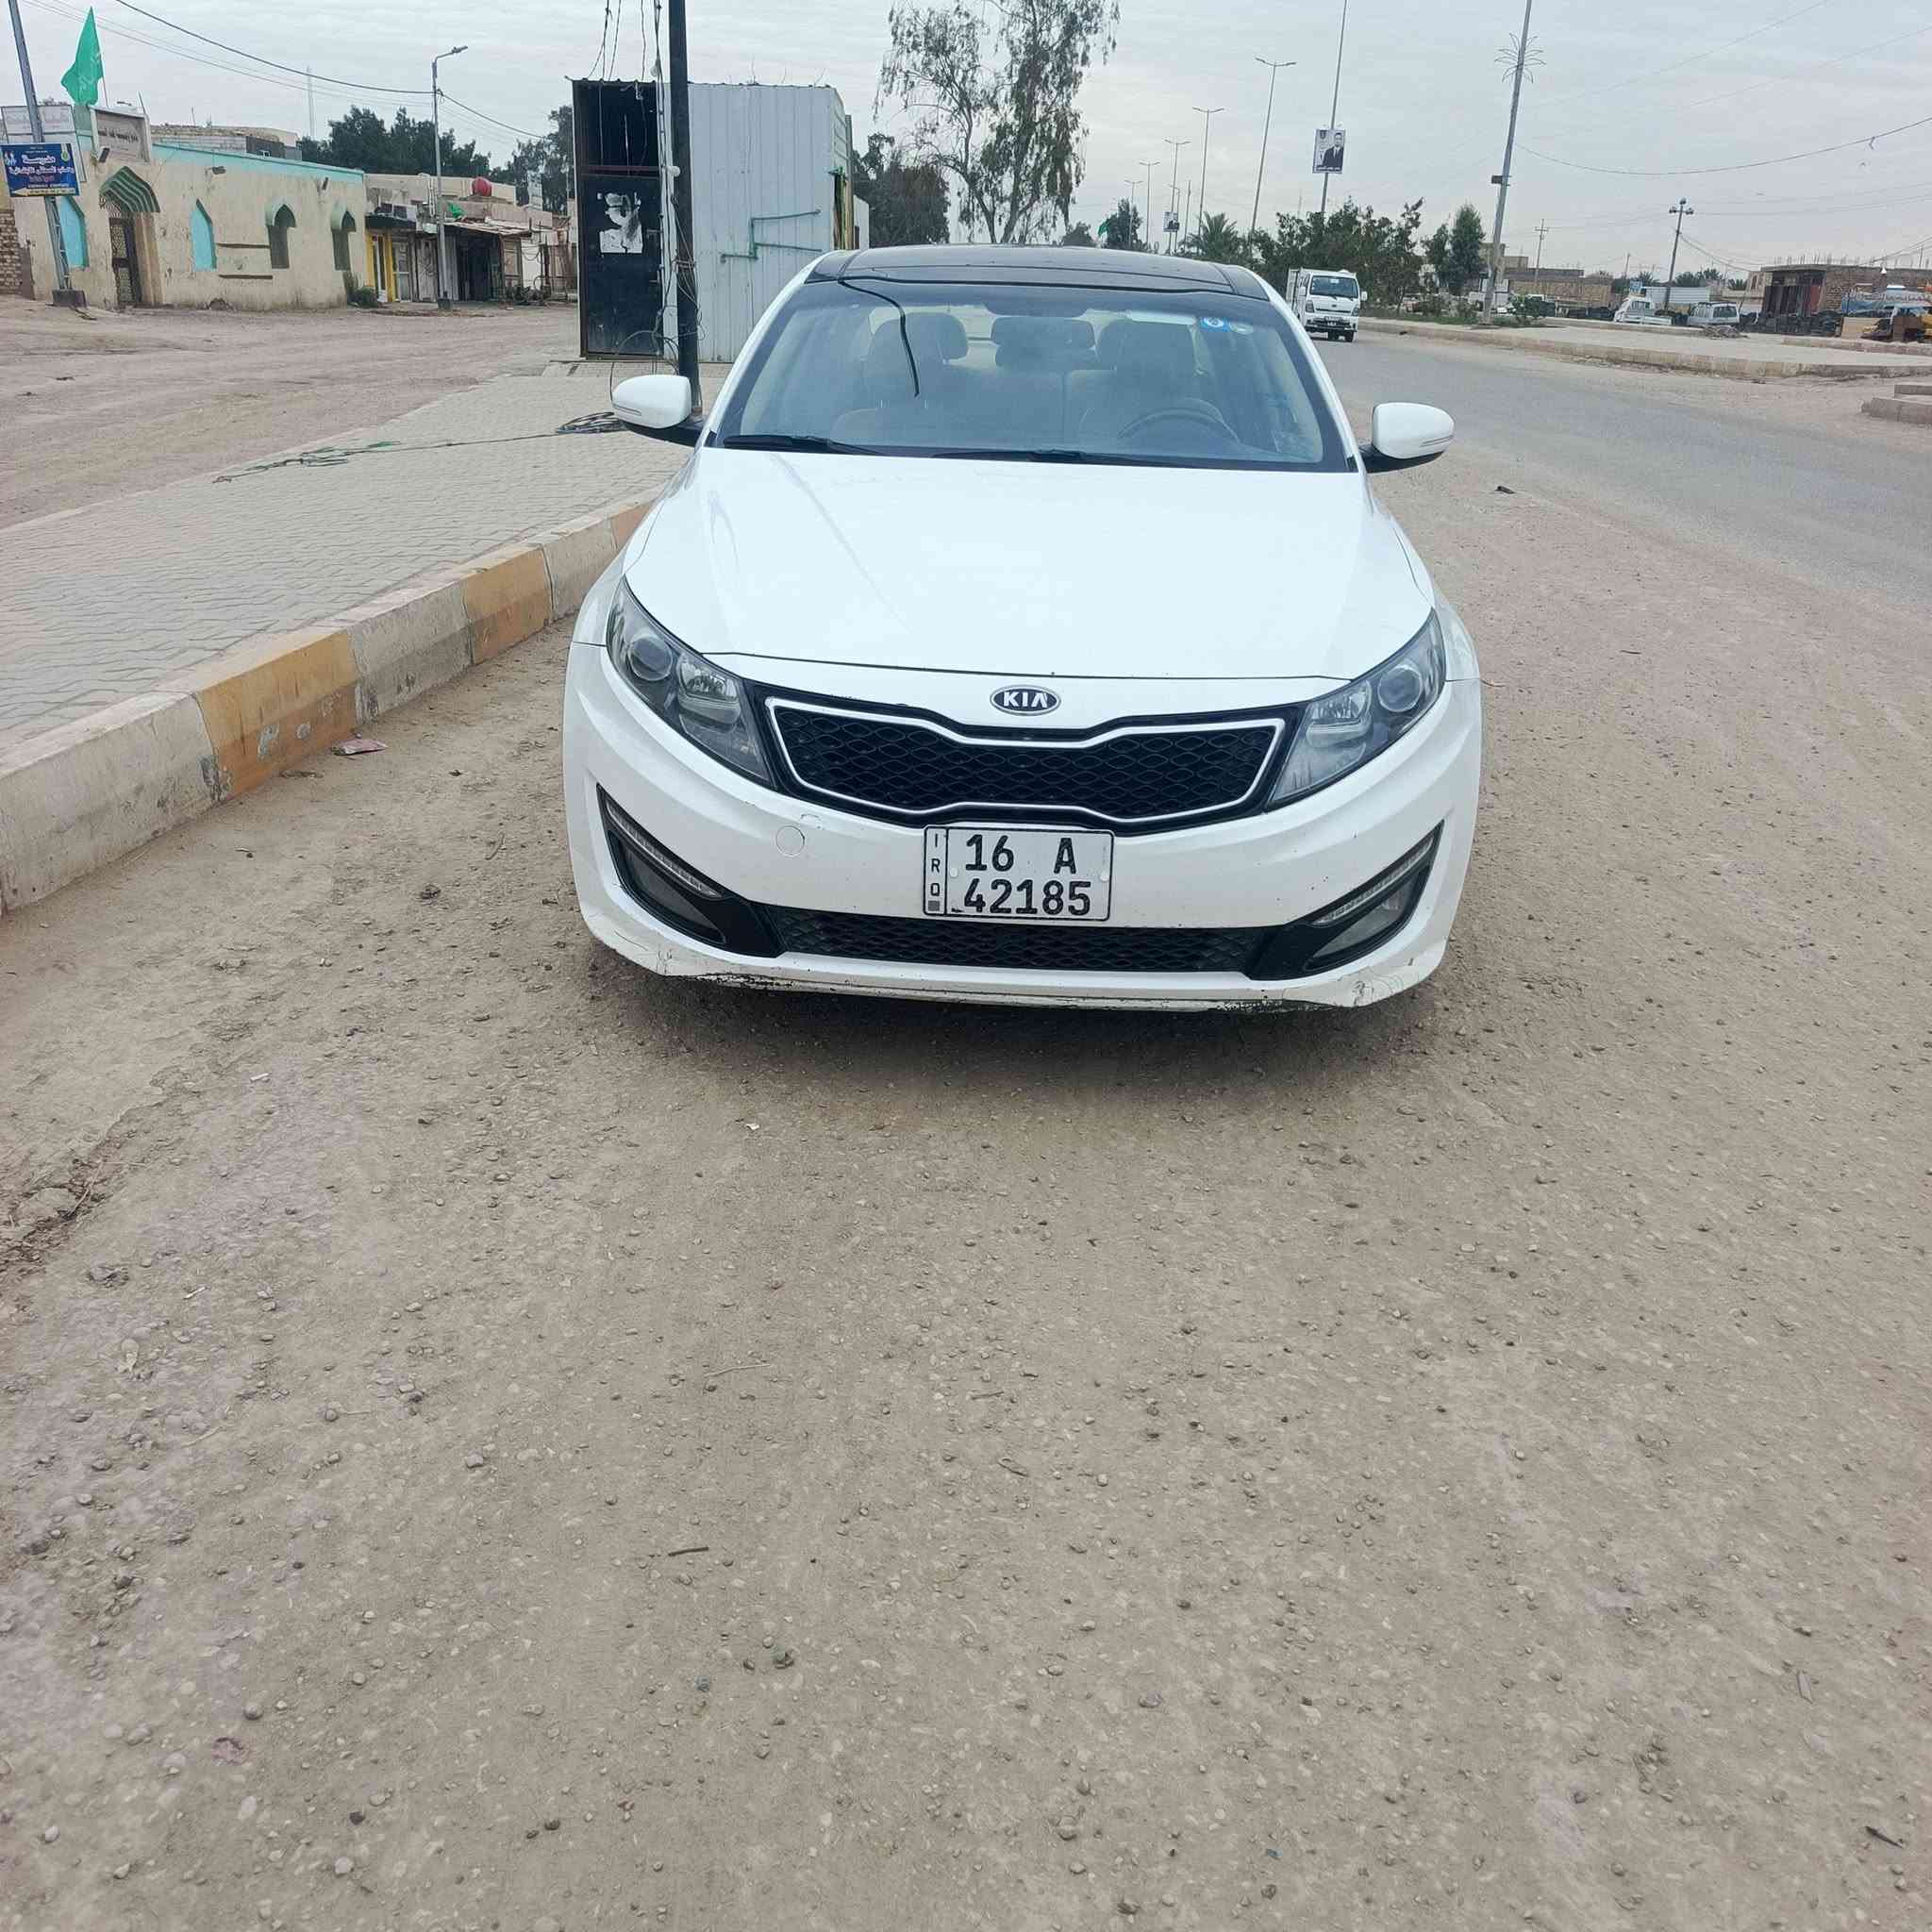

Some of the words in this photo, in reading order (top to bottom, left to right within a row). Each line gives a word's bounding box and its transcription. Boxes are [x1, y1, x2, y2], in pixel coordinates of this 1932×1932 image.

[1003, 691, 1048, 708] KIA
[965, 833, 1015, 873] 16
[1053, 837, 1077, 875] A
[963, 877, 1092, 916] 42185
